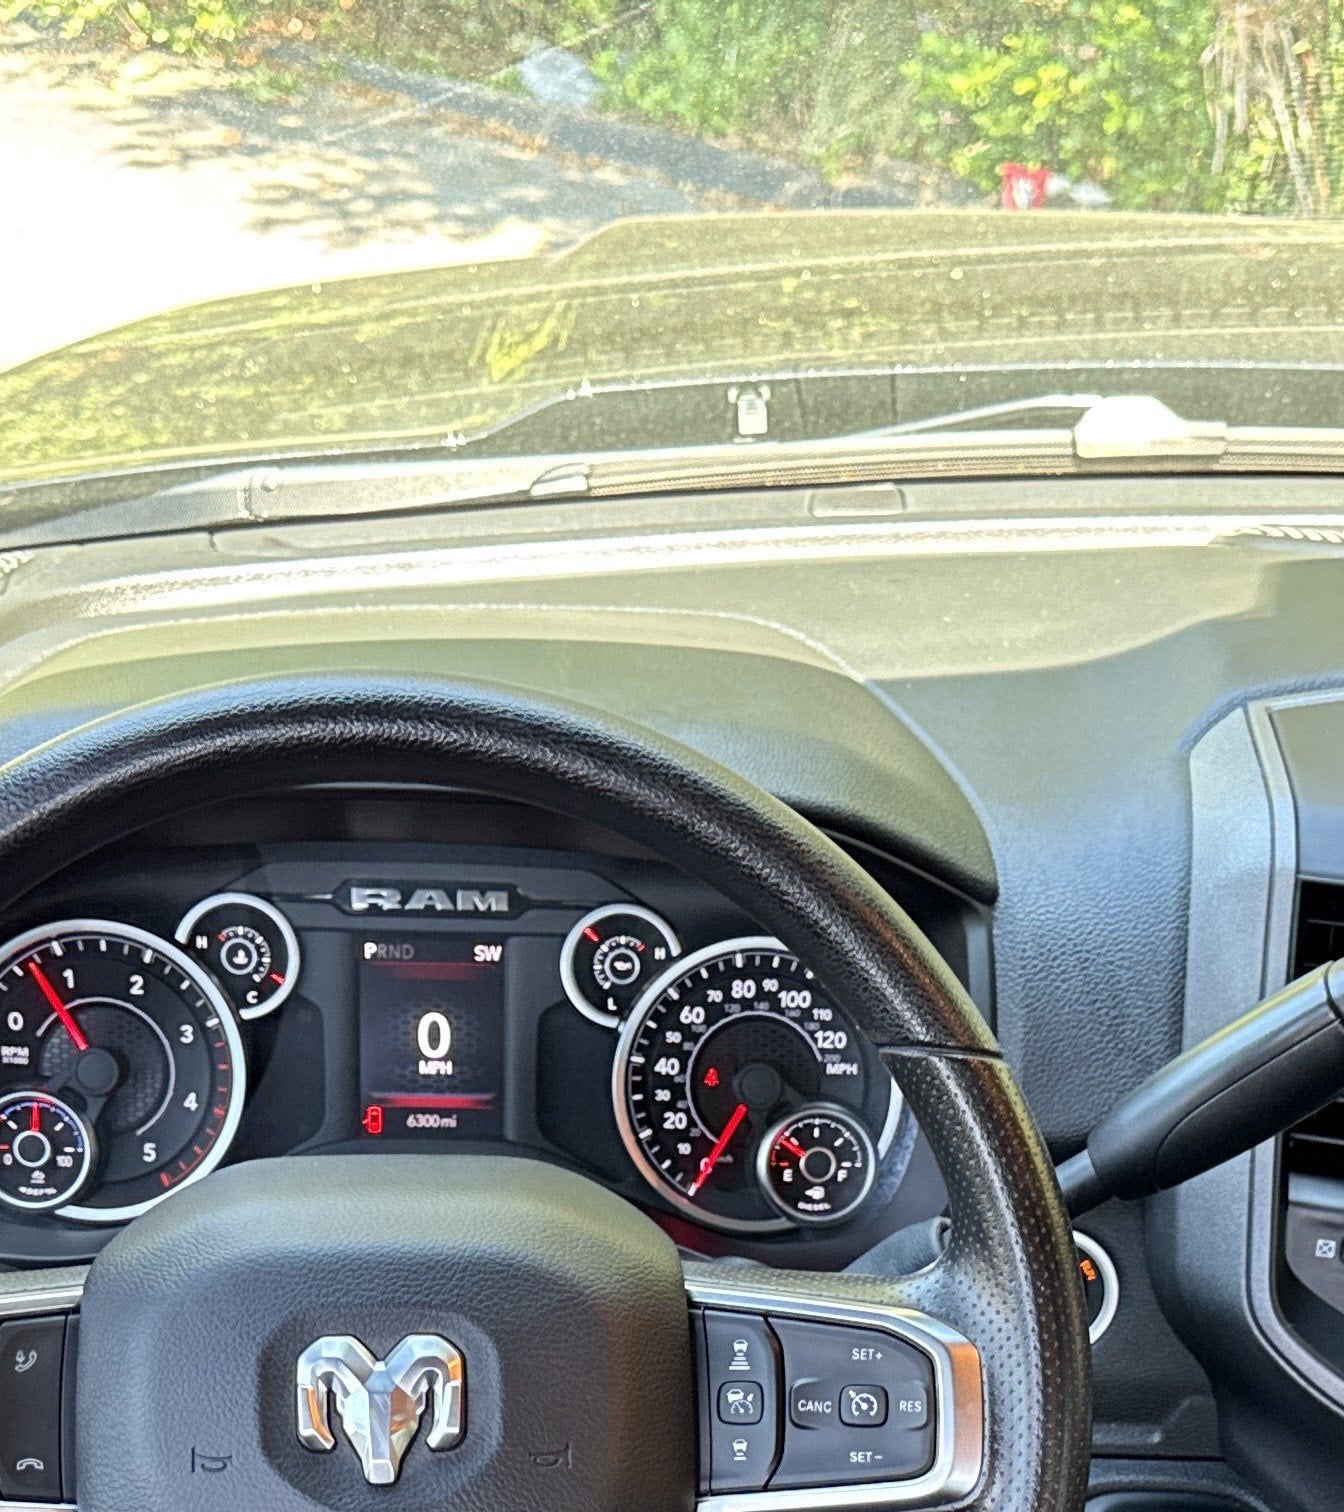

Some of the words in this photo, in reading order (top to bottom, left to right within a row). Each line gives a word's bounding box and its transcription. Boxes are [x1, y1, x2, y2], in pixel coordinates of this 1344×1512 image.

[350, 887, 509, 912] RAM
[196, 936, 207, 949] H
[474, 943, 503, 962] SW
[654, 948, 665, 960] H
[62, 969, 75, 989] 1
[129, 975, 145, 995] 2
[762, 979, 779, 992] 90
[707, 990, 723, 1002] 70
[731, 979, 756, 999] 80
[246, 990, 258, 1004] C
[607, 997, 617, 1011] L
[778, 990, 811, 1009] 100
[8, 1011, 24, 1031] 0
[679, 1006, 705, 1024] 60
[812, 1008, 832, 1021] 110
[180, 1025, 194, 1043] 3
[417, 1011, 451, 1059] 0
[665, 1031, 682, 1044] 50
[814, 1031, 847, 1050] 120
[418, 1060, 452, 1075] MPH
[654, 1057, 680, 1076] 40
[825, 1063, 858, 1075] MPH
[183, 1092, 198, 1111] 4
[655, 1089, 671, 1102] 30
[663, 1112, 687, 1130] 20
[142, 1143, 157, 1162] 5
[677, 1143, 691, 1155] 10
[783, 1169, 793, 1182] E
[837, 1170, 848, 1182] F
[798, 1399, 832, 1414] CANC
[899, 1400, 922, 1413] RES
